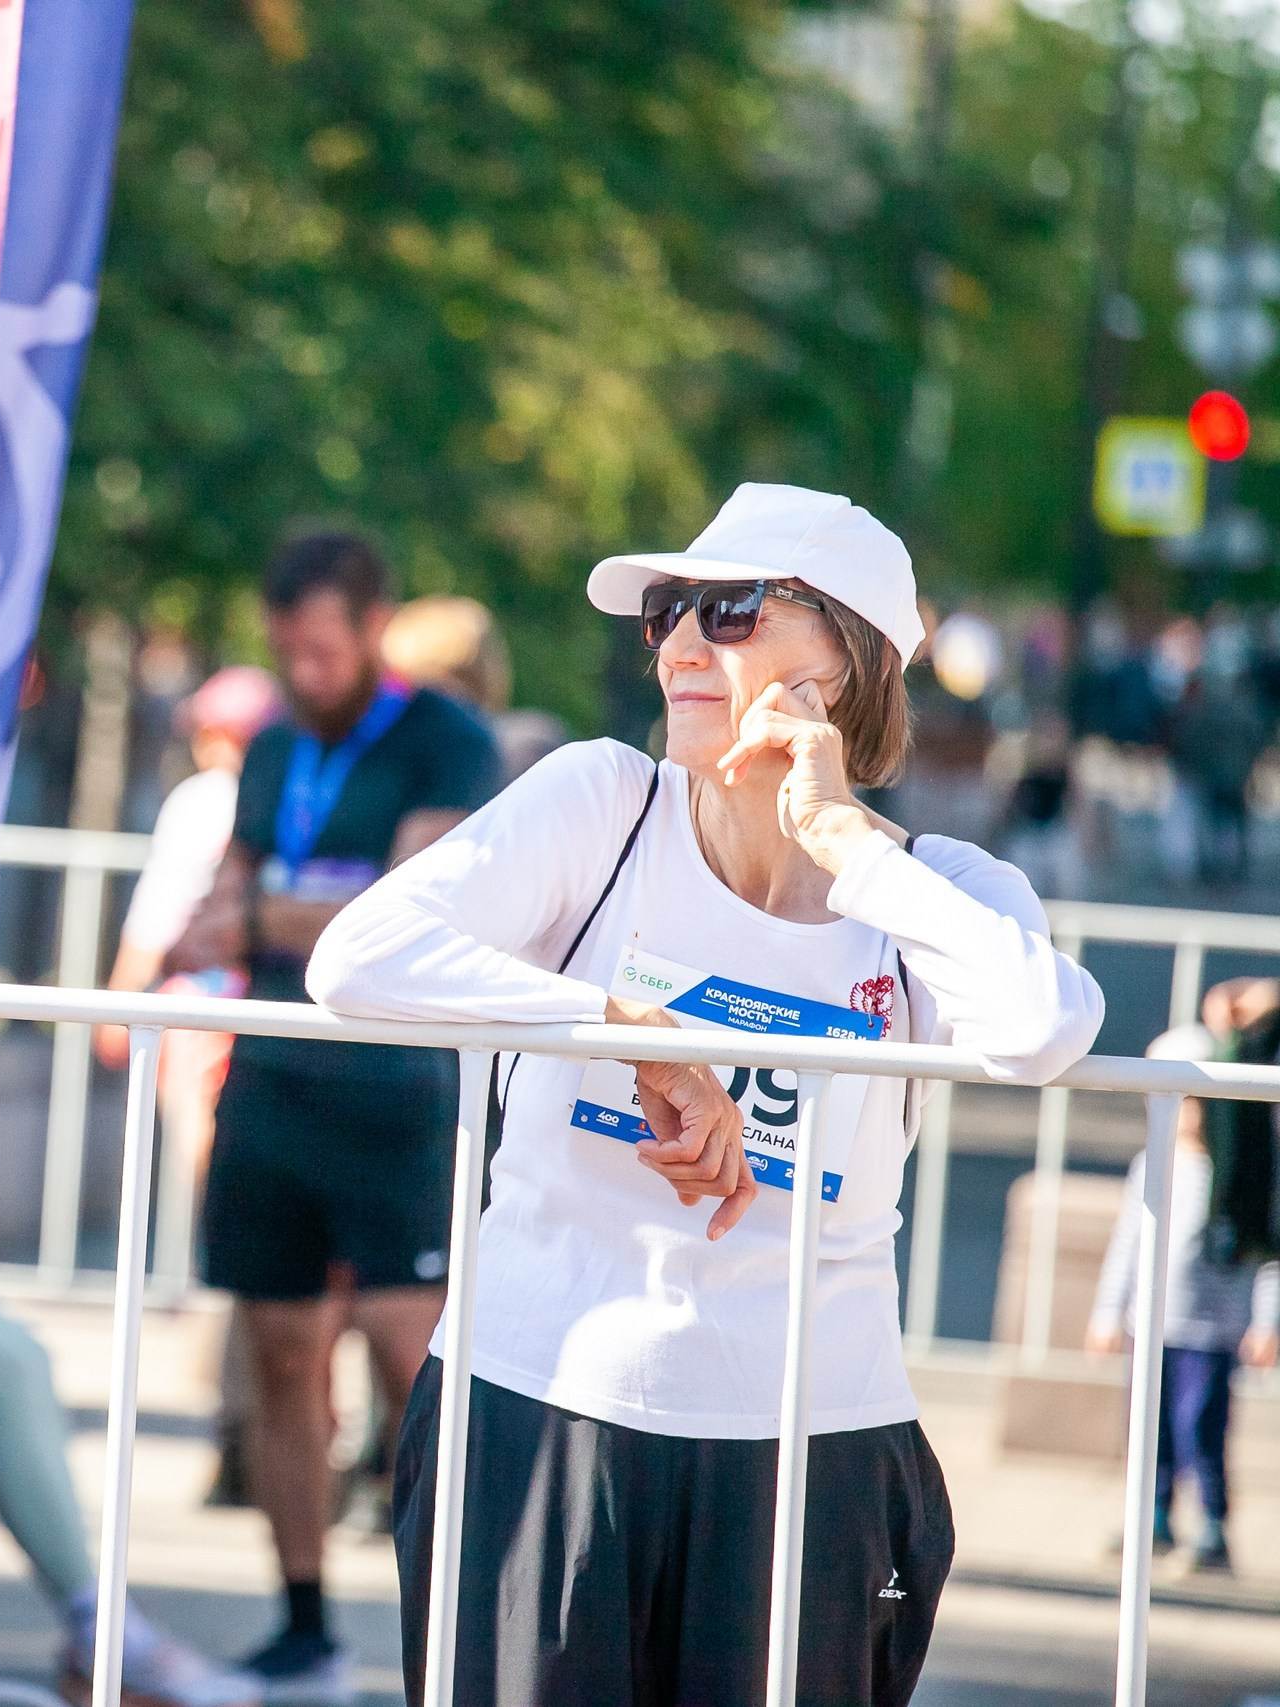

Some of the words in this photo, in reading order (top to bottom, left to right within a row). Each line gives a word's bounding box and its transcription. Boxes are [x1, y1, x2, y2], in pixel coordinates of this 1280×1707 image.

[639, 974, 673, 991] СБЕР
[705, 987, 801, 1021] КРАСНОЯРСКИЕ
[728, 1005, 773, 1024] МОСТЫ
[727, 1016, 768, 1032] МАРАФОН
[825, 1026, 856, 1040] 1628
[597, 1110, 620, 1124] 400
[741, 1126, 796, 1151] СЛАНА
